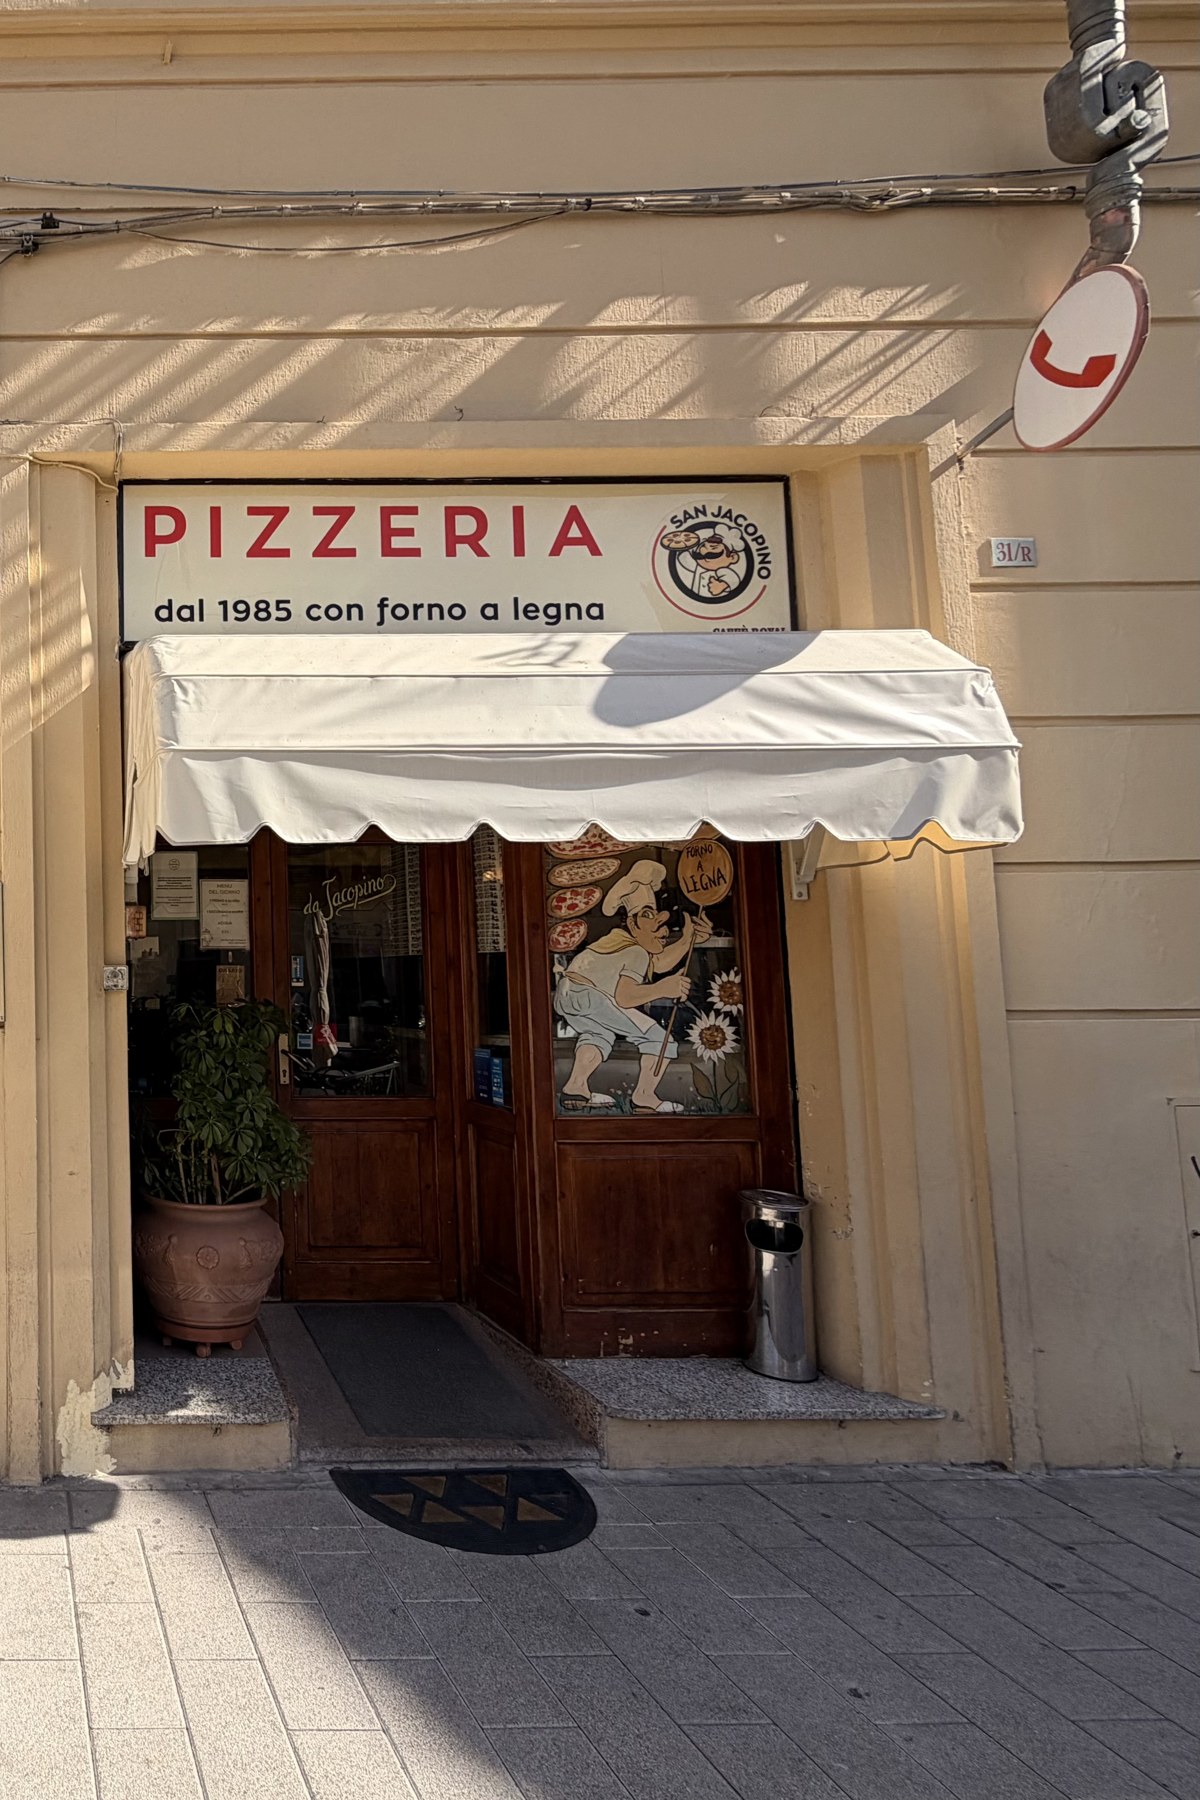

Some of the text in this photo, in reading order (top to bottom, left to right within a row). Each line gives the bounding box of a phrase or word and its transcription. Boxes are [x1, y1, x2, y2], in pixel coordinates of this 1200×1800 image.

[144, 506, 603, 559] PIZZERIA
[670, 504, 771, 580] SAN JACOPINO
[996, 542, 1033, 562] 31/R
[154, 596, 605, 627] dal 1985 con forno a legna
[686, 844, 713, 859] FORNO
[697, 860, 704, 872] A
[682, 866, 727, 894] LEGNA
[303, 892, 320, 915] da
